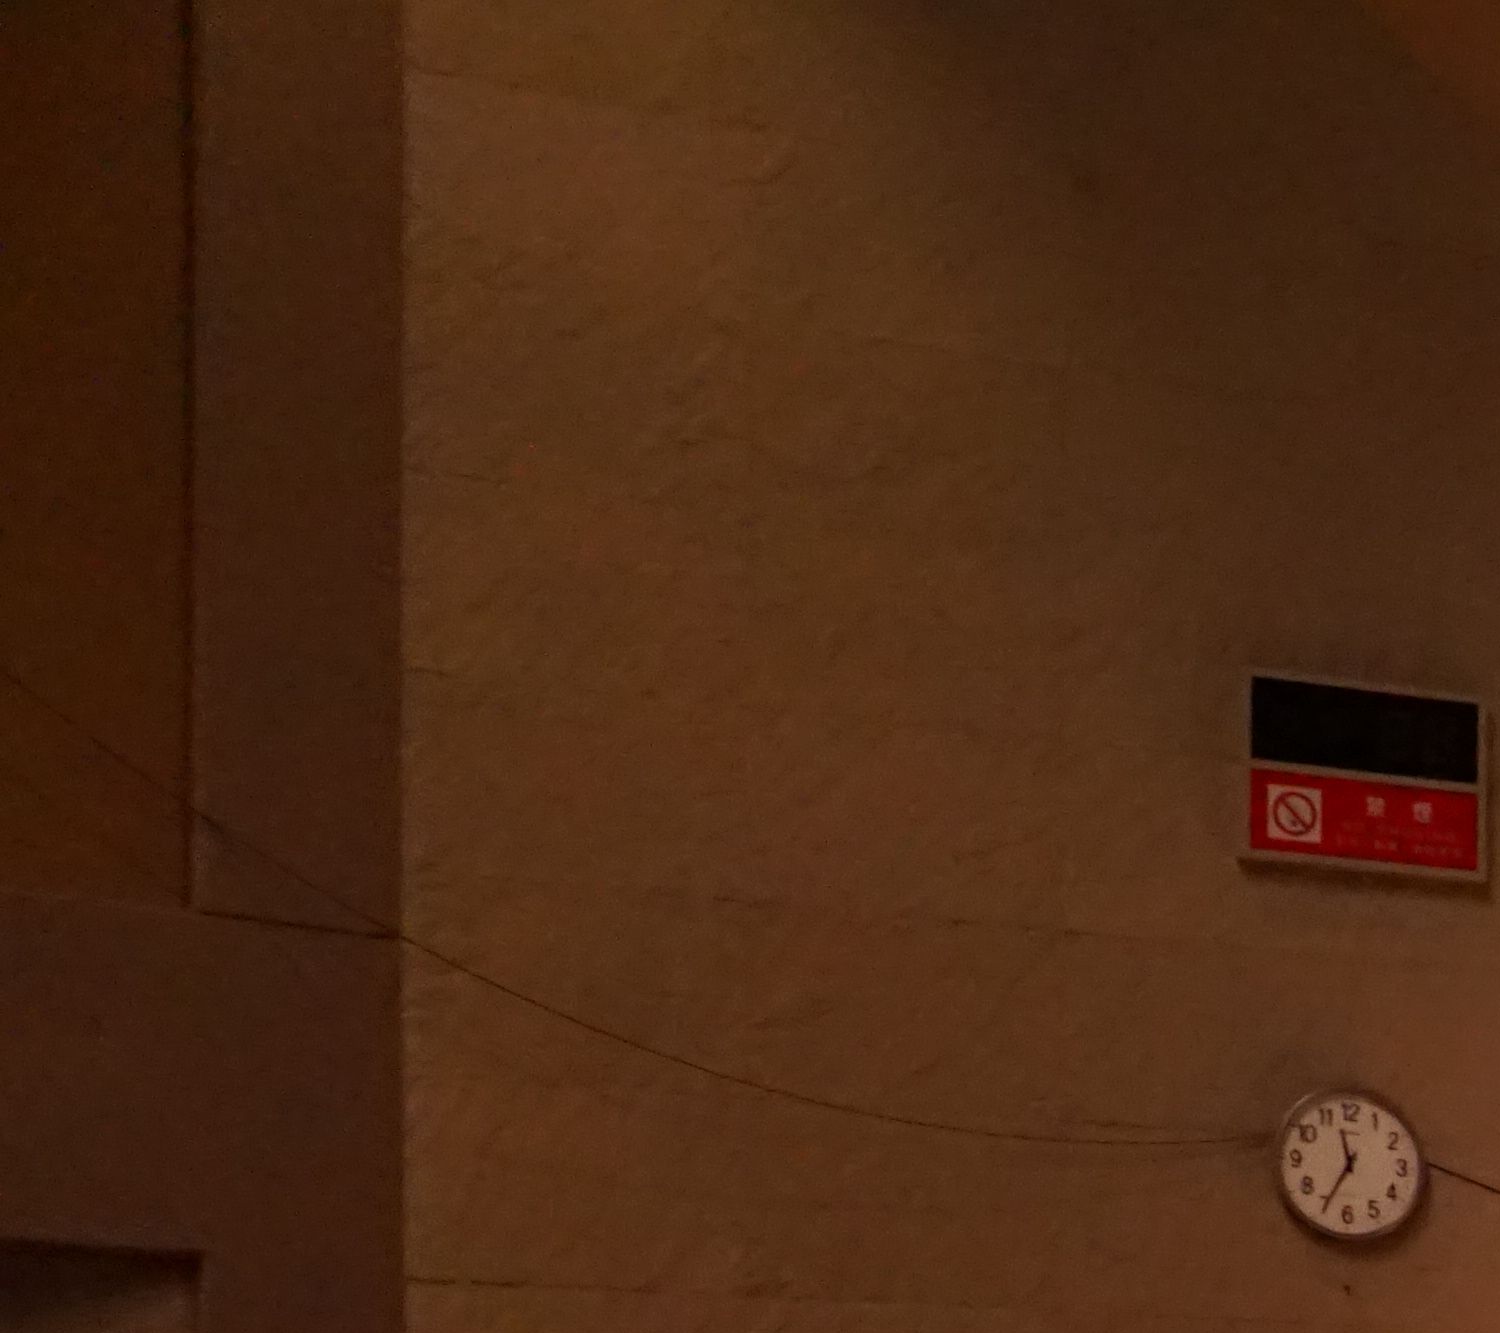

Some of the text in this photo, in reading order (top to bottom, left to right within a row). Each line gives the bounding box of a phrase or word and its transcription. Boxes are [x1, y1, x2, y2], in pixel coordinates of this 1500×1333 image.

[1319, 1109, 1333, 1126] 11
[1342, 1103, 1360, 1122] 12
[1372, 1112, 1379, 1131] 1
[1388, 1132, 1399, 1150] 2
[1290, 1149, 1302, 1167] 9
[1396, 1159, 1407, 1177] 3
[1302, 1176, 1313, 1195] 8
[1386, 1183, 1397, 1200] 4
[1342, 1206, 1353, 1224] 6
[1368, 1200, 1380, 1218] 5
